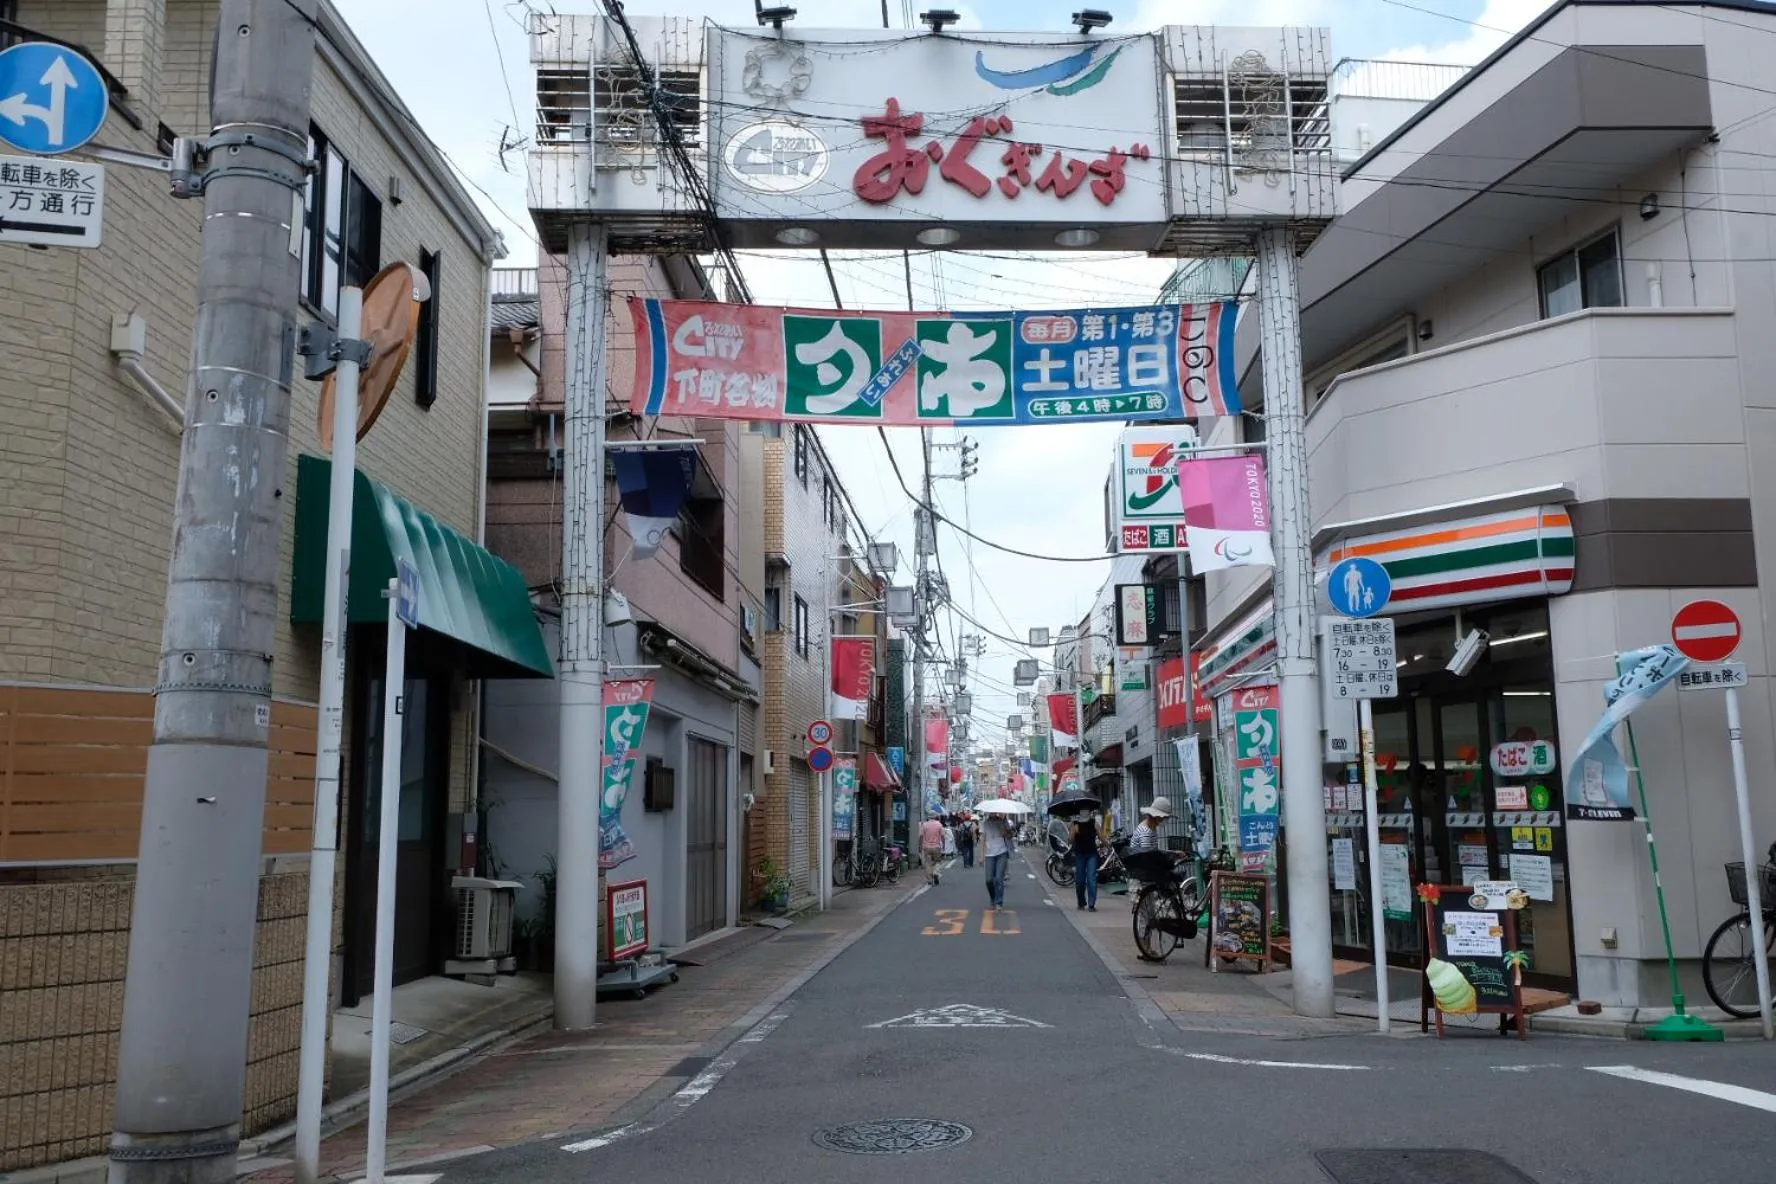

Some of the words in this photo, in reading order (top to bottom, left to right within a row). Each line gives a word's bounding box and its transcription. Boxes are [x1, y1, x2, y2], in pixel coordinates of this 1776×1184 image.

[733, 129, 821, 177] CITY
[853, 97, 1150, 206] おぐぎんざ
[0, 190, 95, 216] 方通行
[672, 314, 745, 361] CITY
[1027, 322, 1071, 340] 毎月
[865, 347, 914, 400] ふれあい
[1022, 342, 1171, 393] 土曜日
[1126, 467, 1148, 475] SEVEN
[1246, 463, 1261, 499] TOKYO
[1251, 500, 1265, 528] 2020
[1124, 528, 1147, 545] たばこ
[1153, 528, 1170, 545] 酒
[1680, 668, 1742, 686] 自転車を除く
[814, 727, 827, 739] 30
[1497, 747, 1527, 767] たばこ
[1533, 745, 1548, 765] 酒
